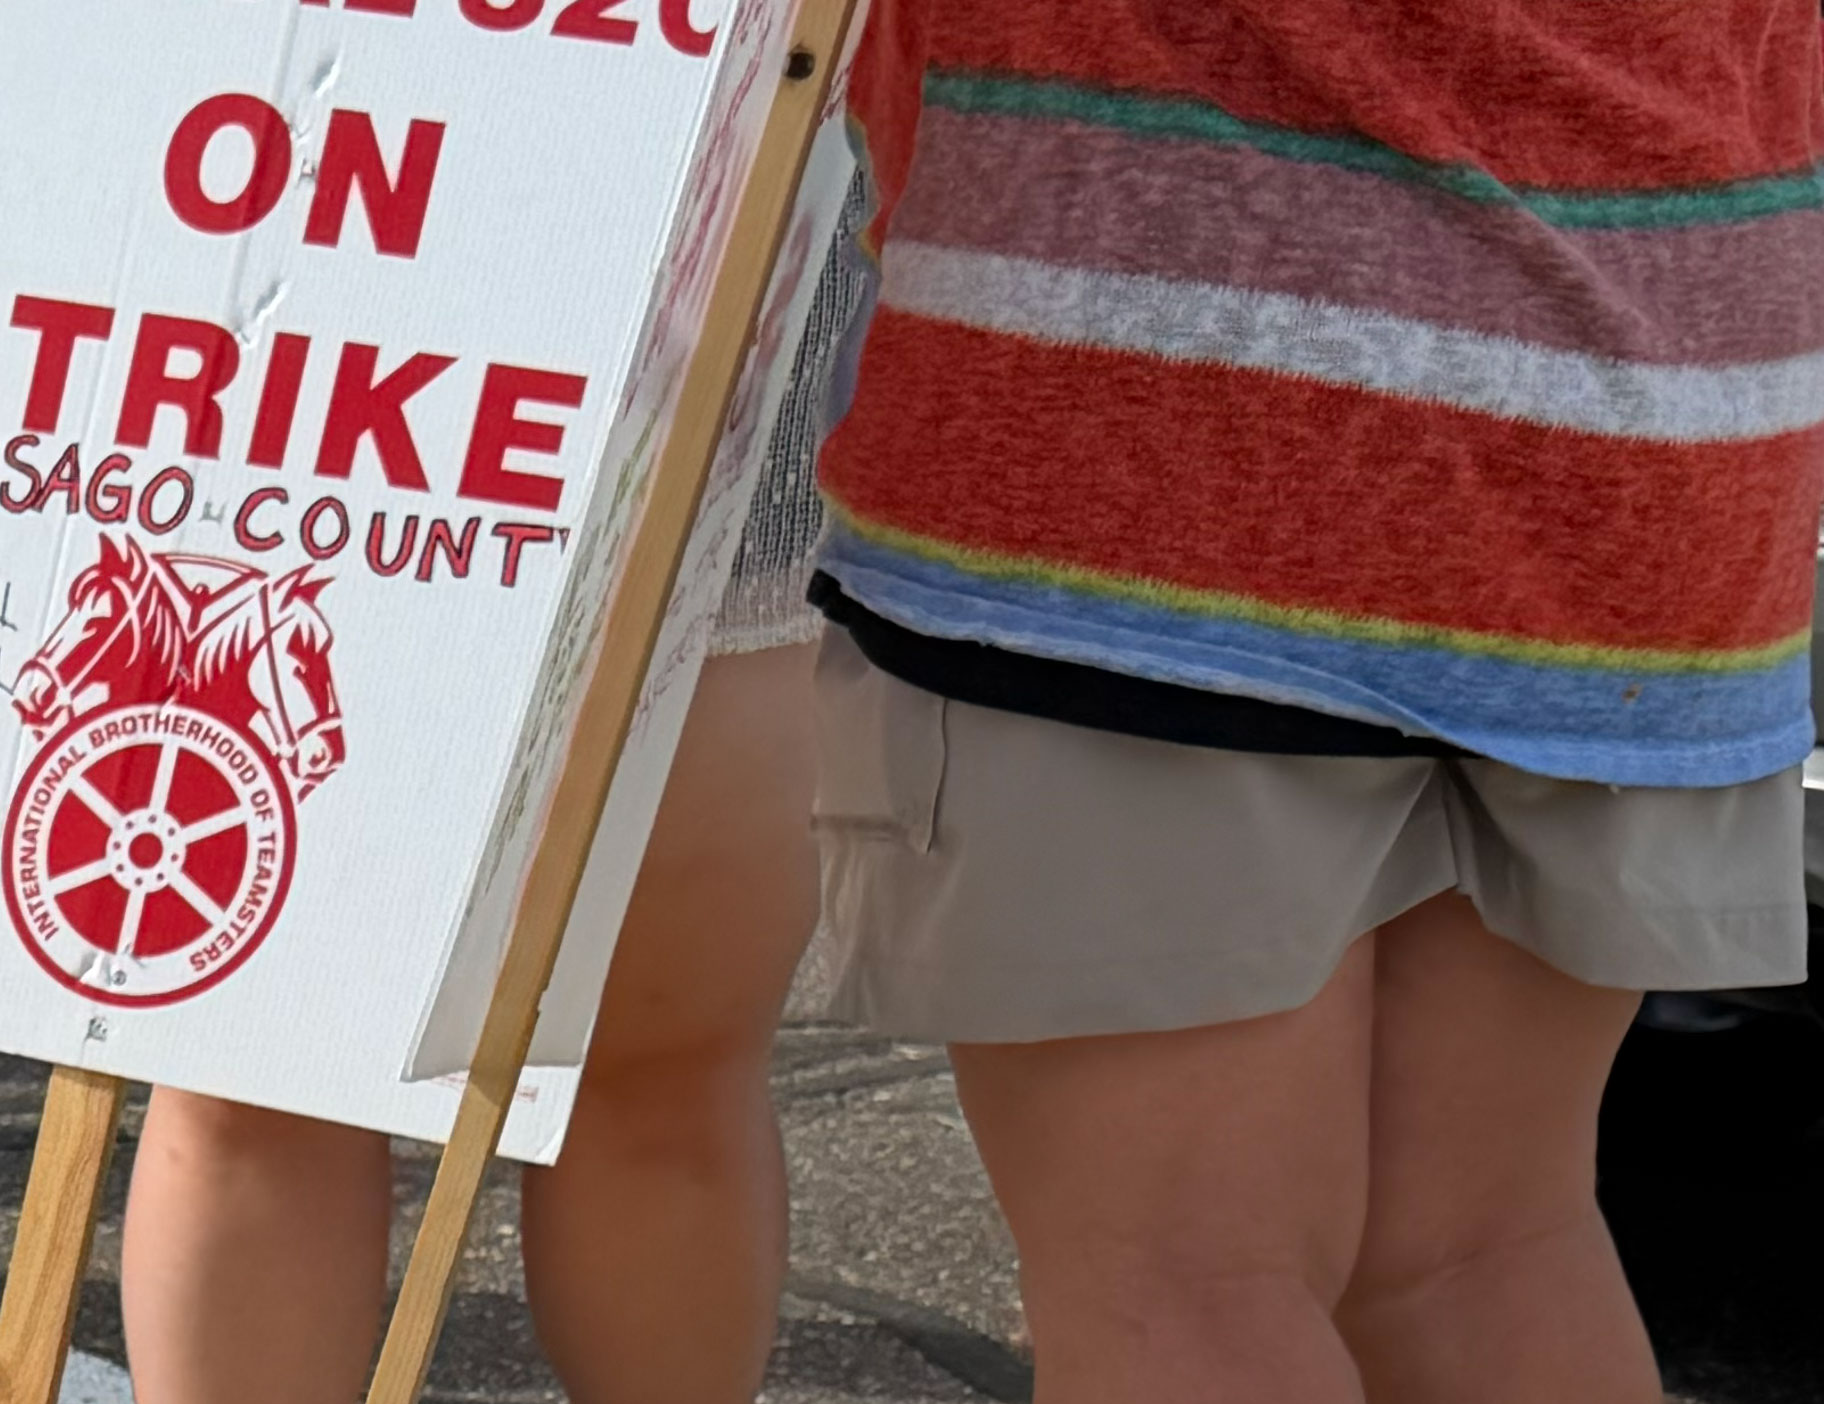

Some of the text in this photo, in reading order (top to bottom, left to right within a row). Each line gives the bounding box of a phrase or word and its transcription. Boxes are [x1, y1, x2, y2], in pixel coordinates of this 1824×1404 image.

[163, 92, 447, 259] ON
[235, 485, 569, 589] COUNT
[19, 711, 278, 974] INTERNATIONAL BROTHERHOOD OF TEAMSTERS
